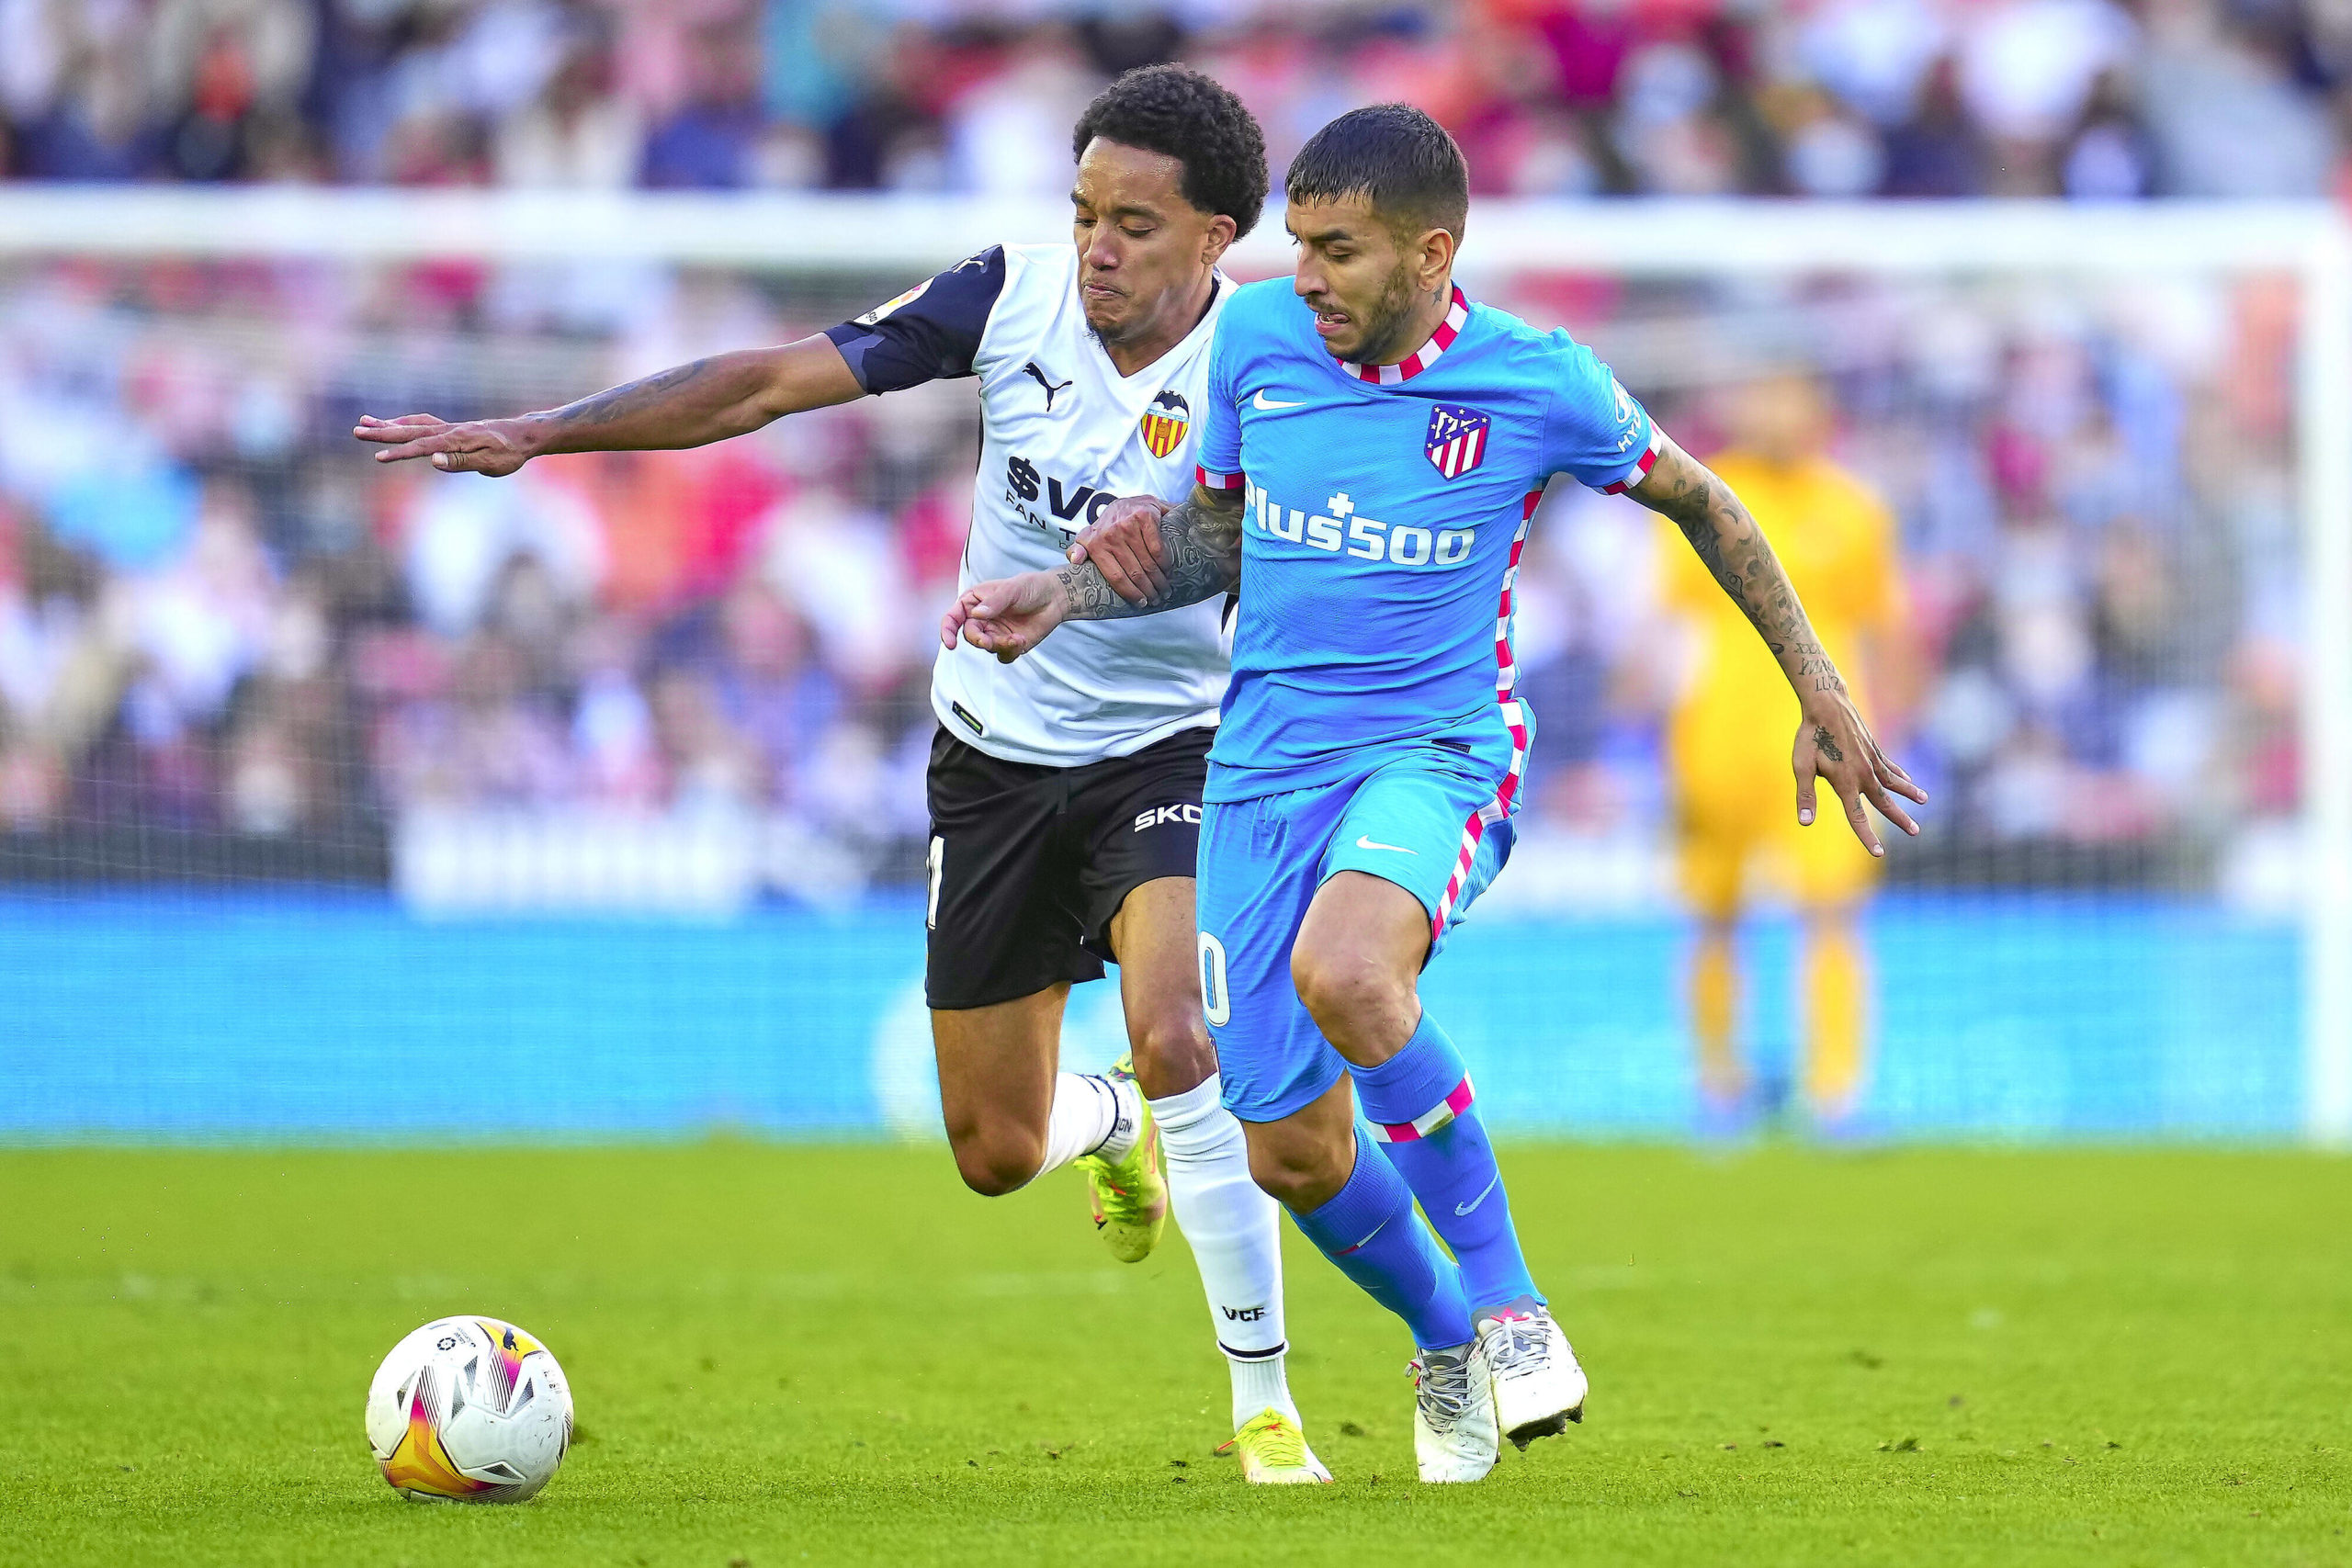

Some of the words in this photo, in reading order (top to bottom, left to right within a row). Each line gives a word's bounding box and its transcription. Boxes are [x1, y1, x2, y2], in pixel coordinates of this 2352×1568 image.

[1135, 804, 1203, 833] SKO
[925, 835, 945, 931] 1
[1221, 1305, 1265, 1322] VCF
